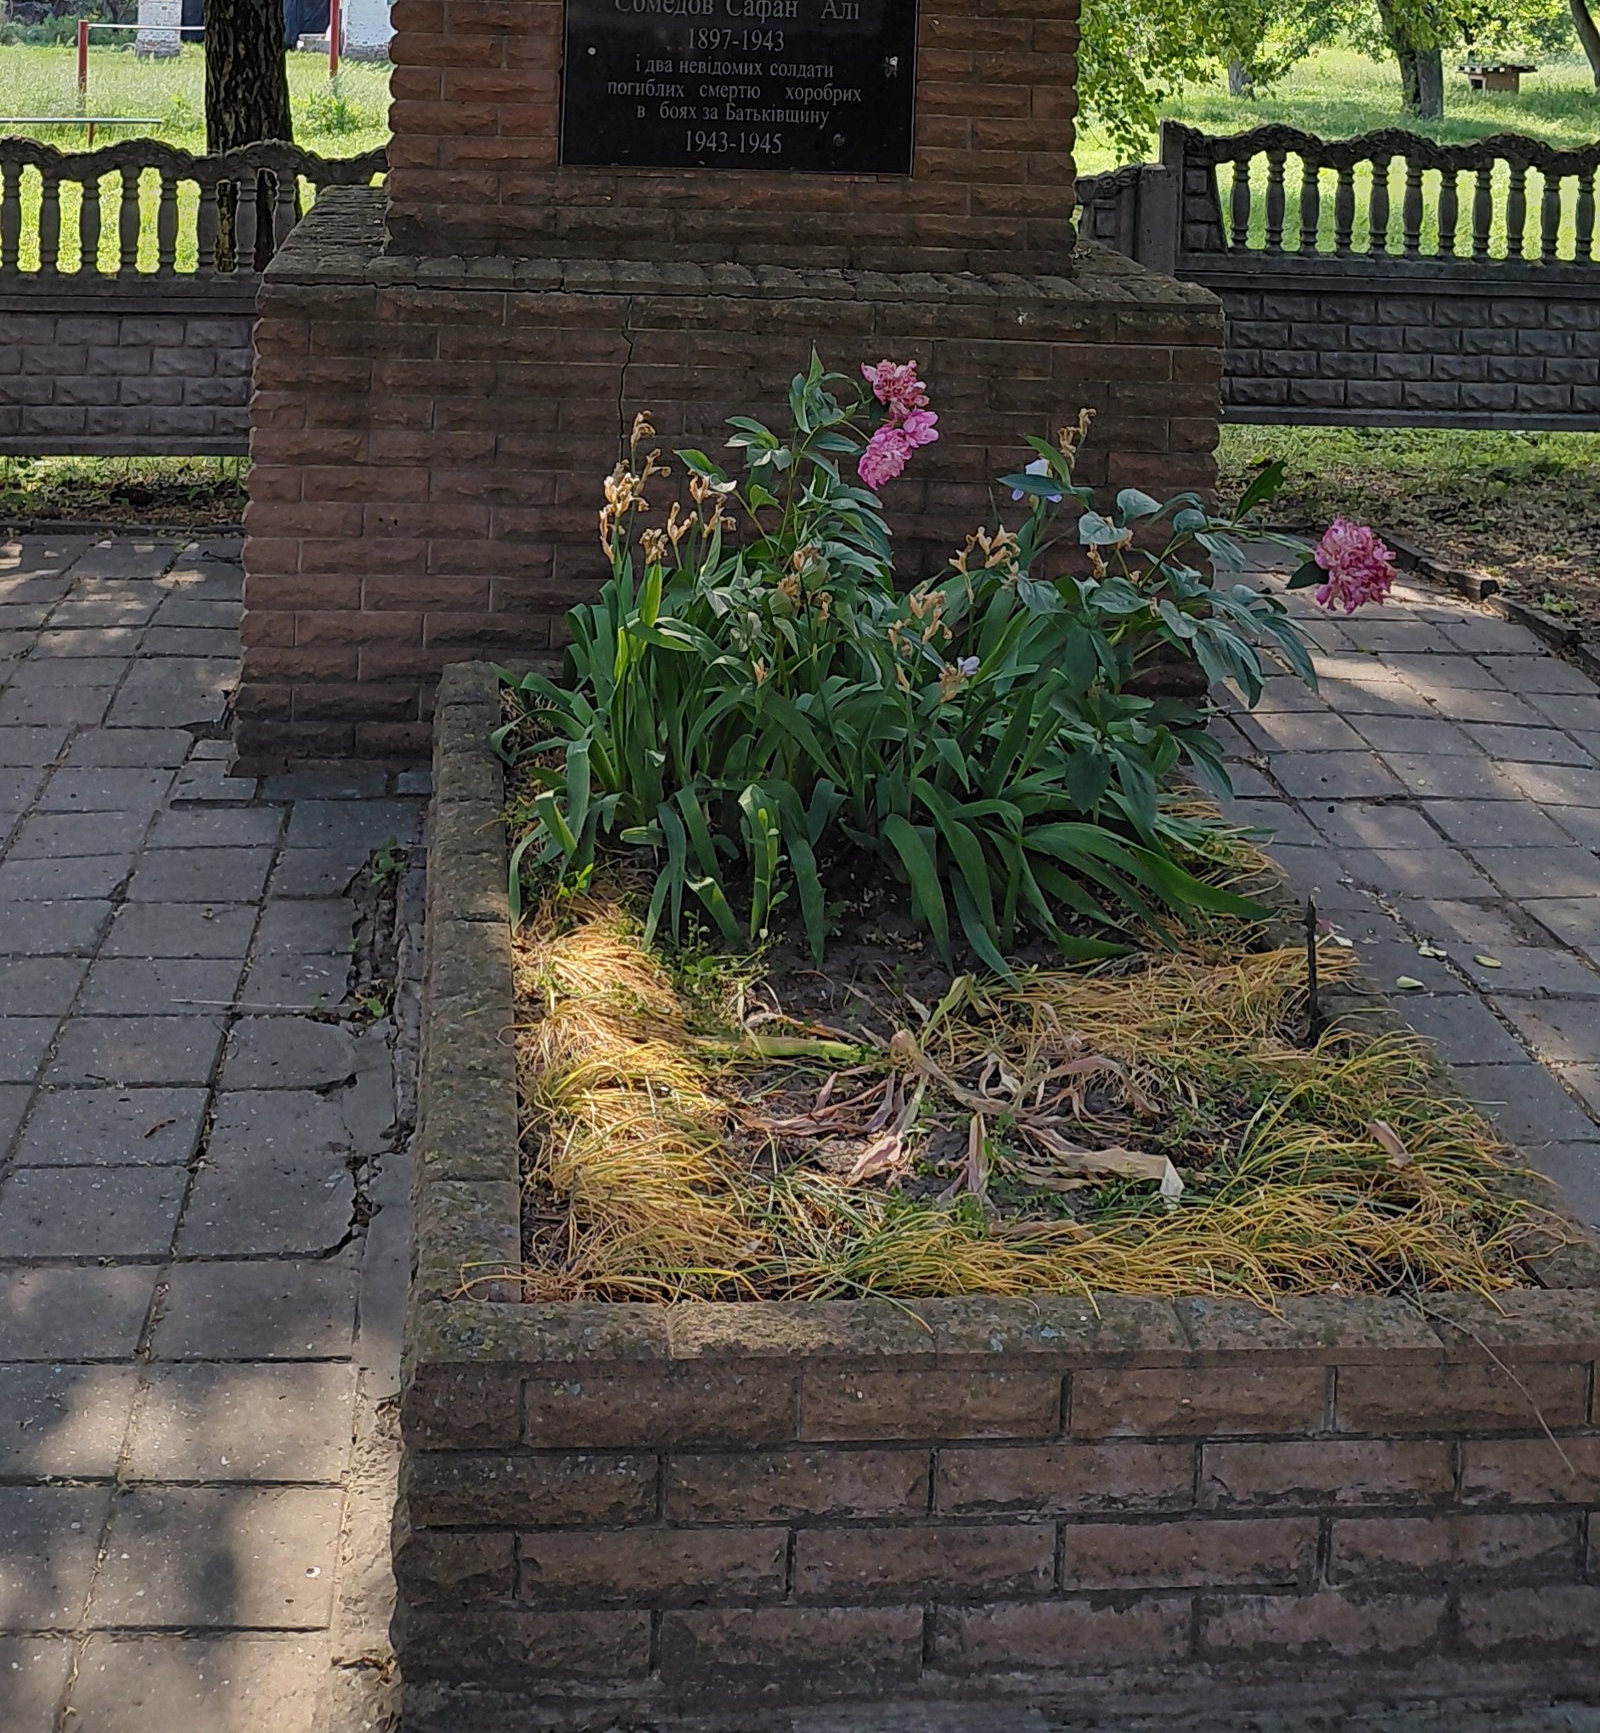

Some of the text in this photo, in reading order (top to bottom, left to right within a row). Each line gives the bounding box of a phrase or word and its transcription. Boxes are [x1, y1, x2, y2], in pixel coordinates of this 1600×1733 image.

[688, 27, 785, 52] 1897-1943
[635, 54, 834, 79] і два невідомих солдати
[607, 78, 862, 106] погиблих смертю хоробрих
[637, 100, 830, 130] в боях за Батьківщину
[686, 129, 783, 154] 1943-1945
